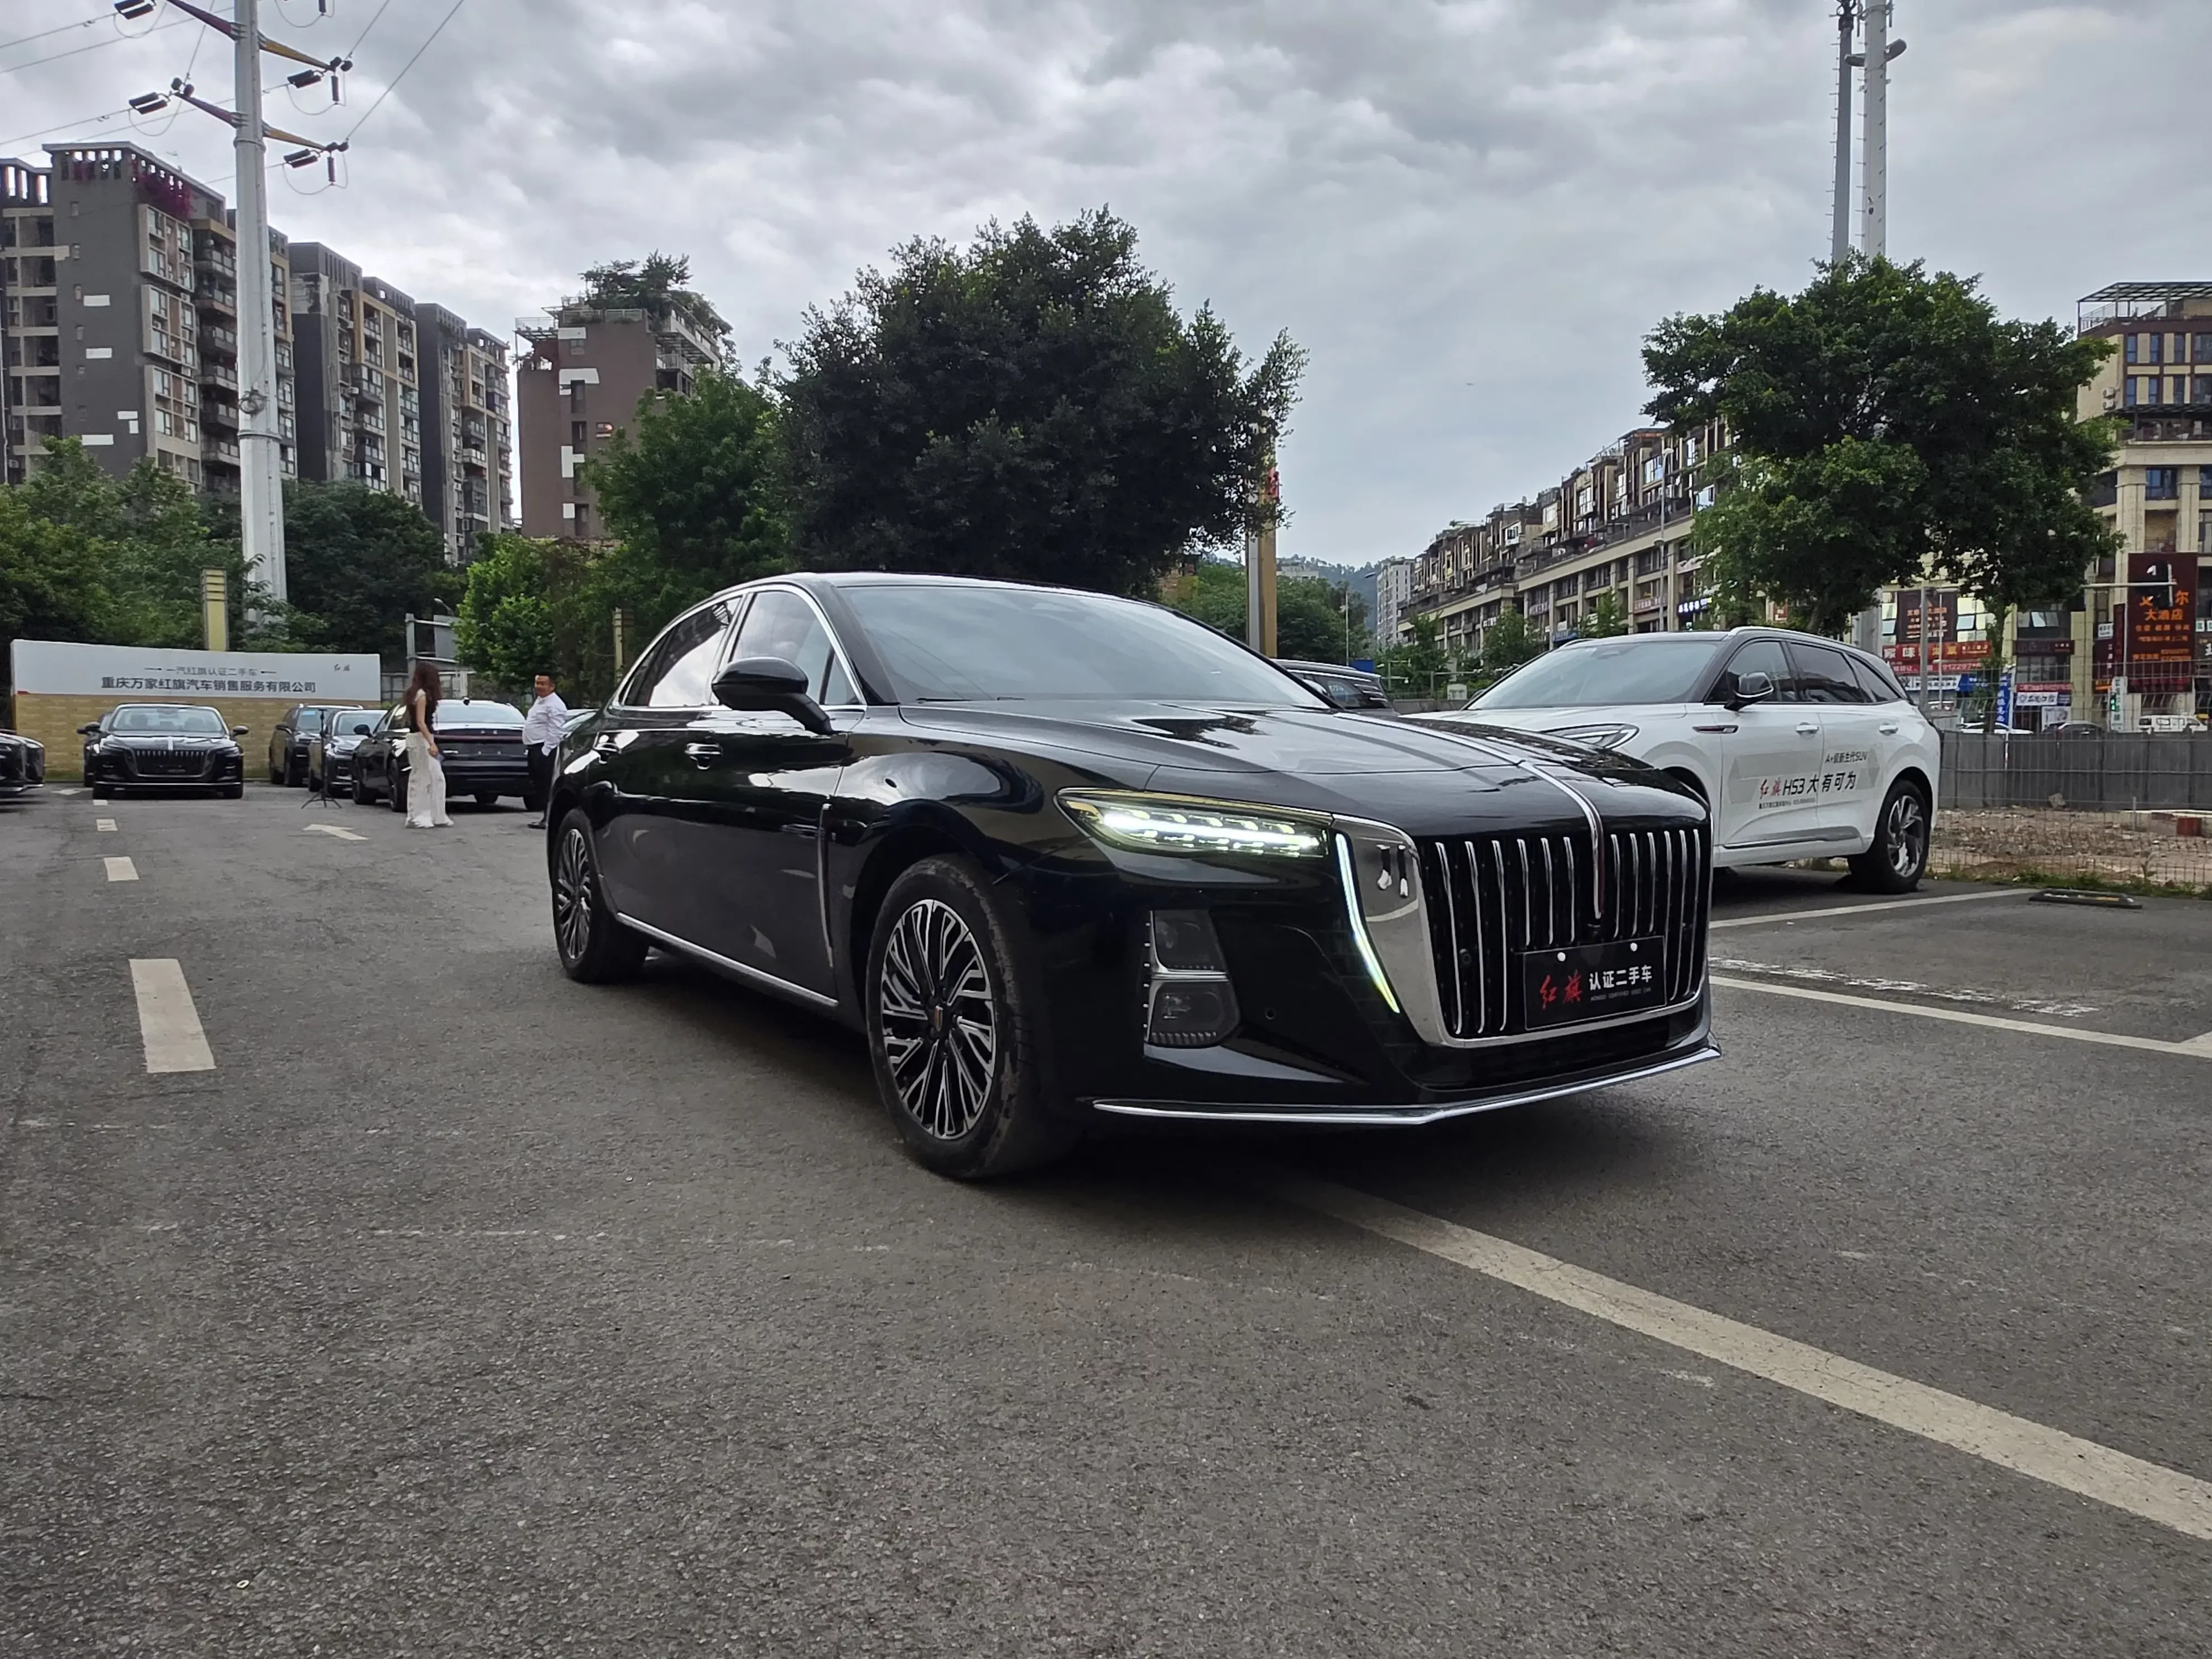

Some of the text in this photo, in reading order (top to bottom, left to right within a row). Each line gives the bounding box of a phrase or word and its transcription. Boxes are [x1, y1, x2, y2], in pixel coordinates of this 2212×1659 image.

[101, 676, 316, 693] 重庆万家红旗汽车销售服务有限公司
[1782, 778, 1806, 796] HS3
[1807, 771, 1856, 795] 大有可为
[1589, 964, 1652, 990] 认证二手车
